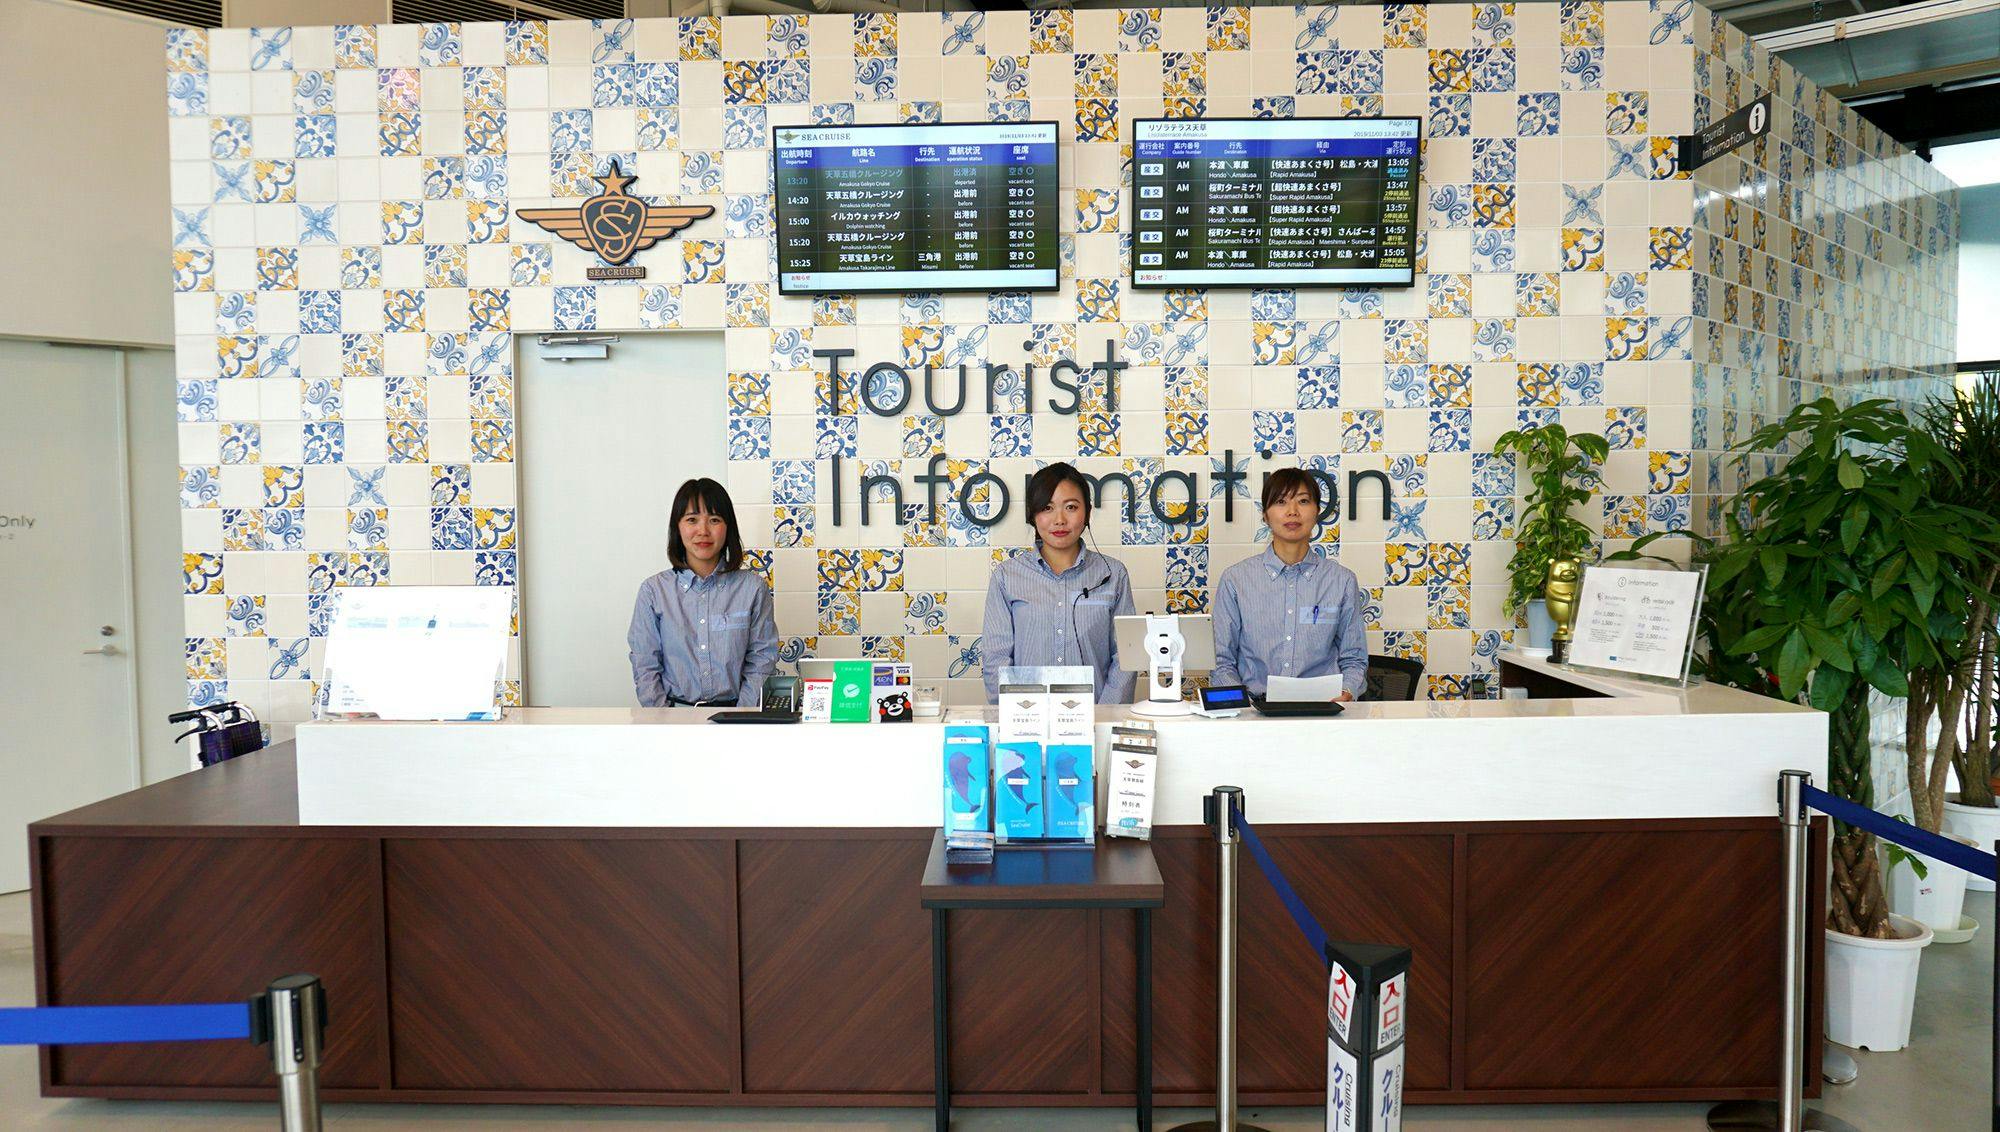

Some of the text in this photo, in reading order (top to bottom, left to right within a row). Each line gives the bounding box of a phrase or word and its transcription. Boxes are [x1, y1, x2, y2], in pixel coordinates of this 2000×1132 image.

[1703, 123, 1726, 145] Tourist
[1013, 145, 1029, 154] 座席
[1703, 131, 1745, 160] Information
[781, 149, 812, 158] 出航時刻
[852, 148, 875, 157] 航路名
[919, 147, 935, 156] 行先
[949, 146, 980, 155] 運航状況
[1177, 161, 1190, 169] AM
[825, 169, 903, 179] 天草五橋クルージング
[954, 167, 976, 176] 出港済
[1009, 167, 1023, 176] 空き
[1009, 188, 1023, 197] 空き
[1176, 184, 1189, 192] AM
[826, 190, 904, 200] 天草五橋クルージング
[954, 189, 977, 198] 出港前
[954, 210, 978, 219] 出港前
[1009, 209, 1024, 219] 空き
[1176, 206, 1189, 214] AM
[831, 211, 900, 221] イルカウォッチング
[827, 232, 905, 242] 天草五橋クルージング
[954, 231, 978, 240] 出港前
[1009, 230, 1024, 239] 空き
[1175, 229, 1188, 237] AM
[840, 254, 893, 263] 天草宝島ライン
[918, 252, 941, 261] 三角港
[955, 252, 978, 261] 出港前
[1009, 251, 1024, 260] 空き
[1175, 251, 1188, 259] AM
[812, 338, 1129, 417] Tourist
[0, 515, 36, 529] Only
[1332, 968, 1350, 1021] 入口
[1383, 981, 1400, 1028] 入口
[1329, 1007, 1347, 1037] ENTER
[1380, 1024, 1403, 1045] ENTER
[1393, 1064, 1401, 1118] Cruising
[1344, 1072, 1353, 1127] Cruising
